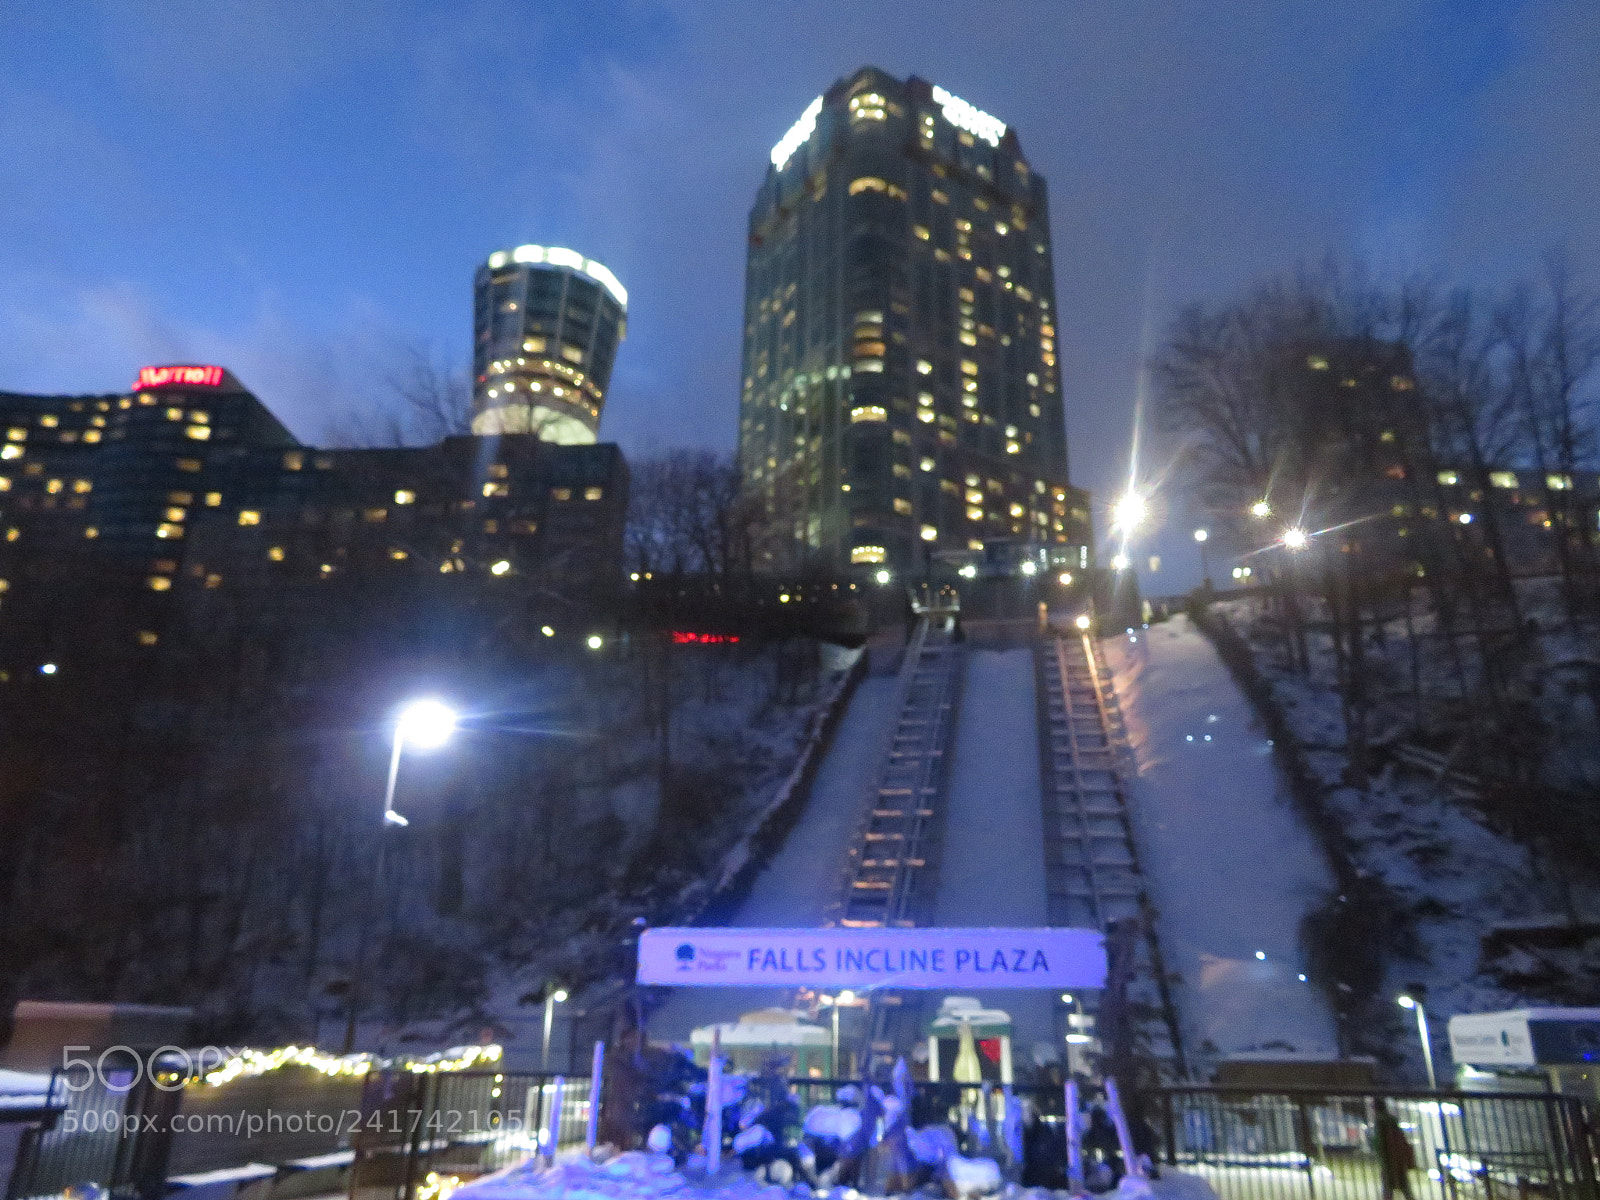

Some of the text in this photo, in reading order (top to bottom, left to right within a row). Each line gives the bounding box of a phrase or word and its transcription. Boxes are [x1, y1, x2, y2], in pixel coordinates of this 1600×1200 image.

[748, 948, 827, 972] FALLS
[836, 948, 946, 973] INCLINE
[954, 948, 1050, 973] PLAZA
